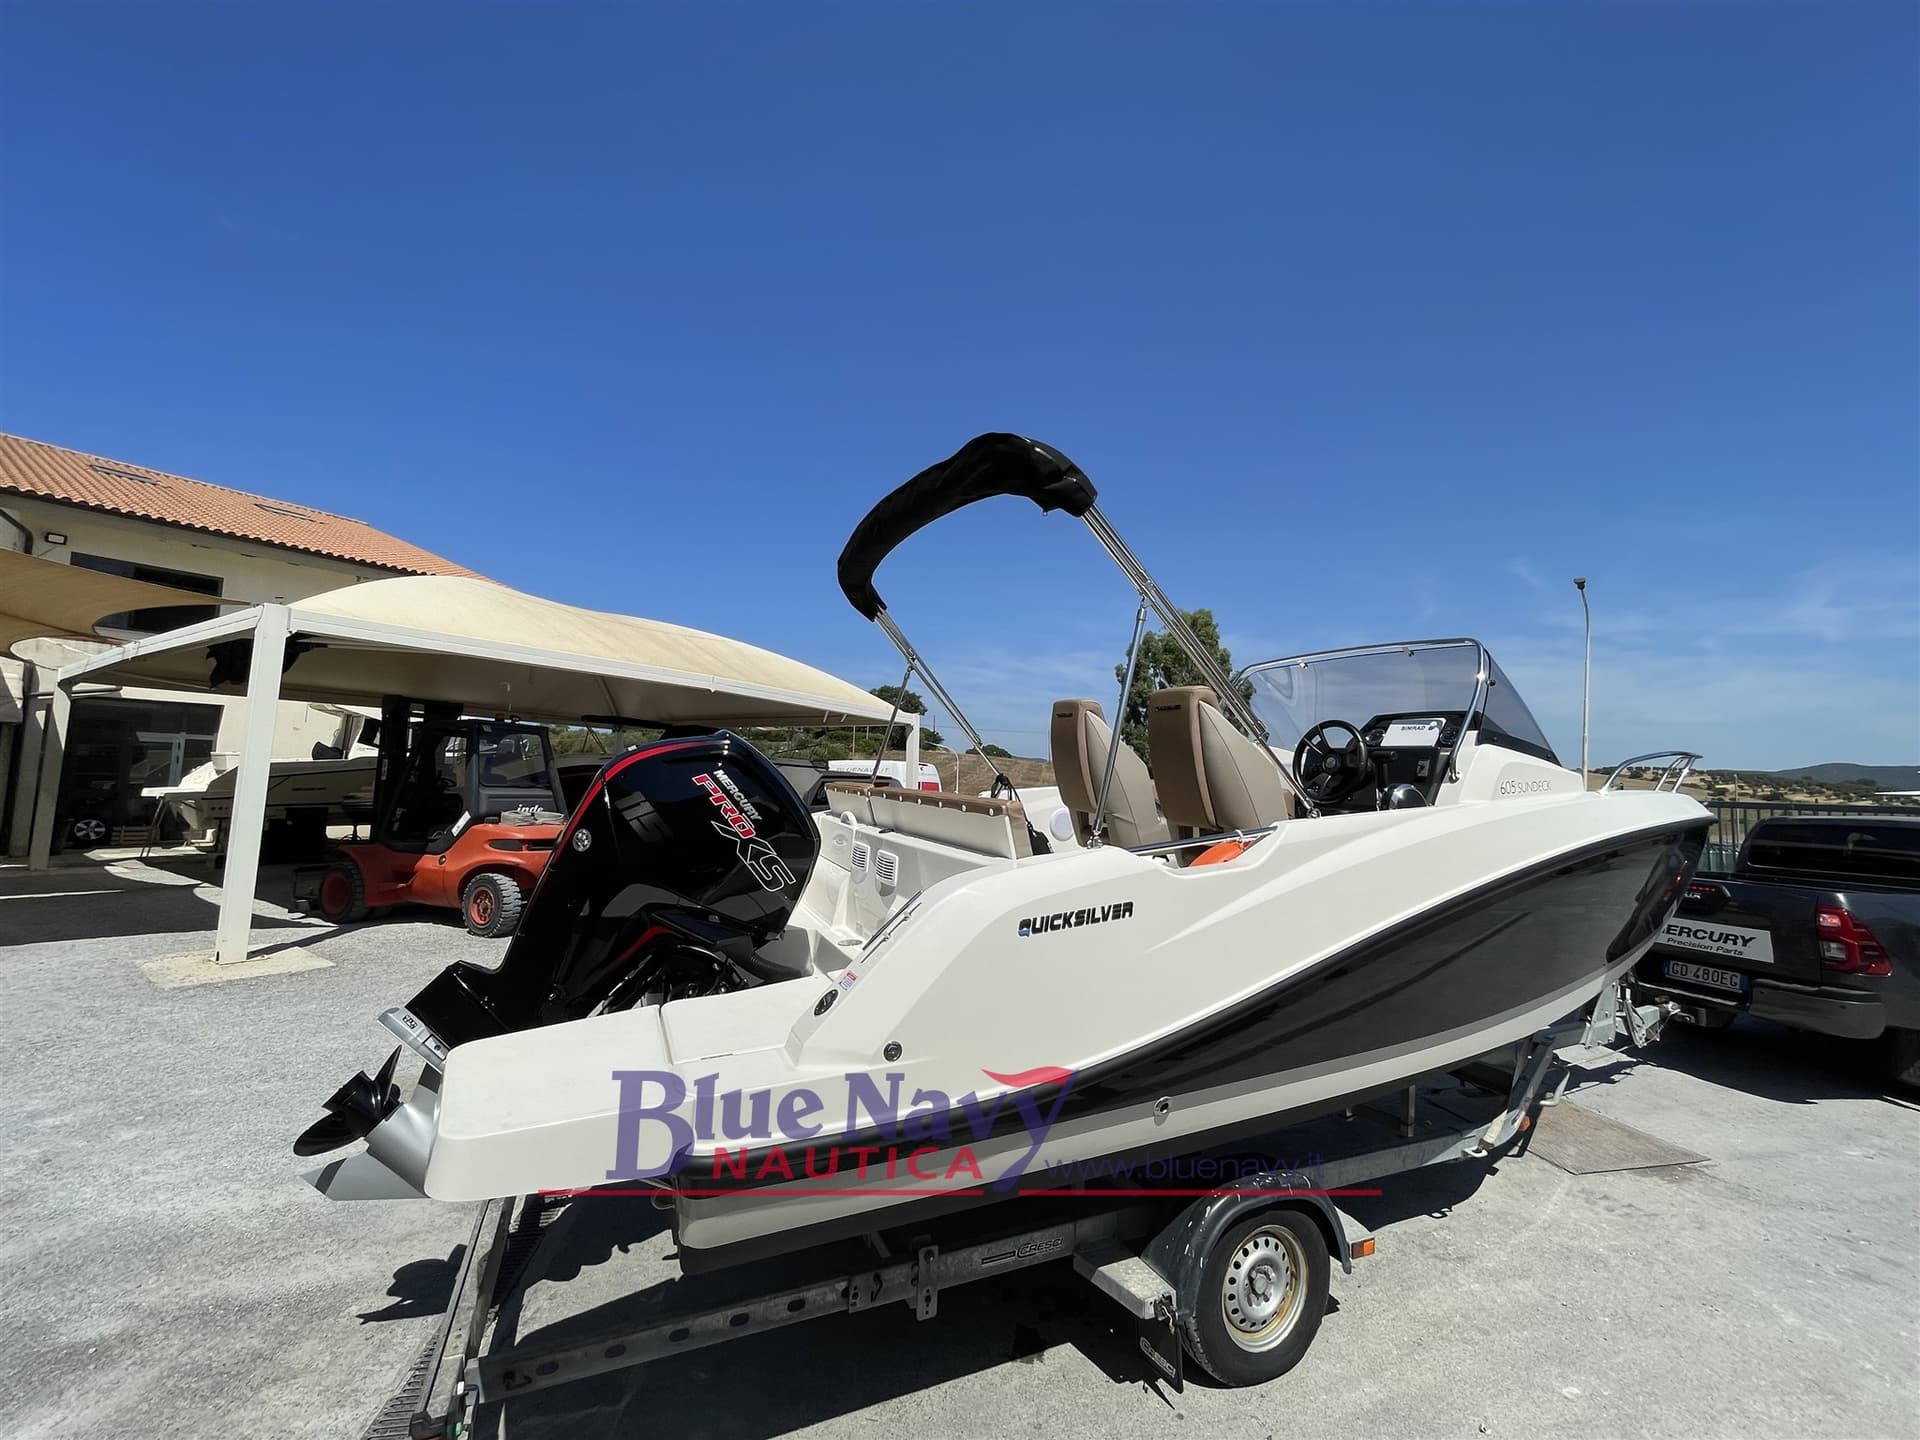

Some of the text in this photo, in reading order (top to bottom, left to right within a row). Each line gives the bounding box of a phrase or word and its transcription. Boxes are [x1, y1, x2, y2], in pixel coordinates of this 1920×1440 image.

[713, 769, 763, 821] MERCURY
[1500, 780, 1552, 795] 605 SUNDECK
[692, 773, 797, 892] PRO XS
[1018, 901, 1134, 938] QUICKSILVER
[1662, 924, 1757, 947] ERCURY
[1667, 937, 1744, 956] Precision Parts
[1672, 962, 1739, 987] GD 480EG
